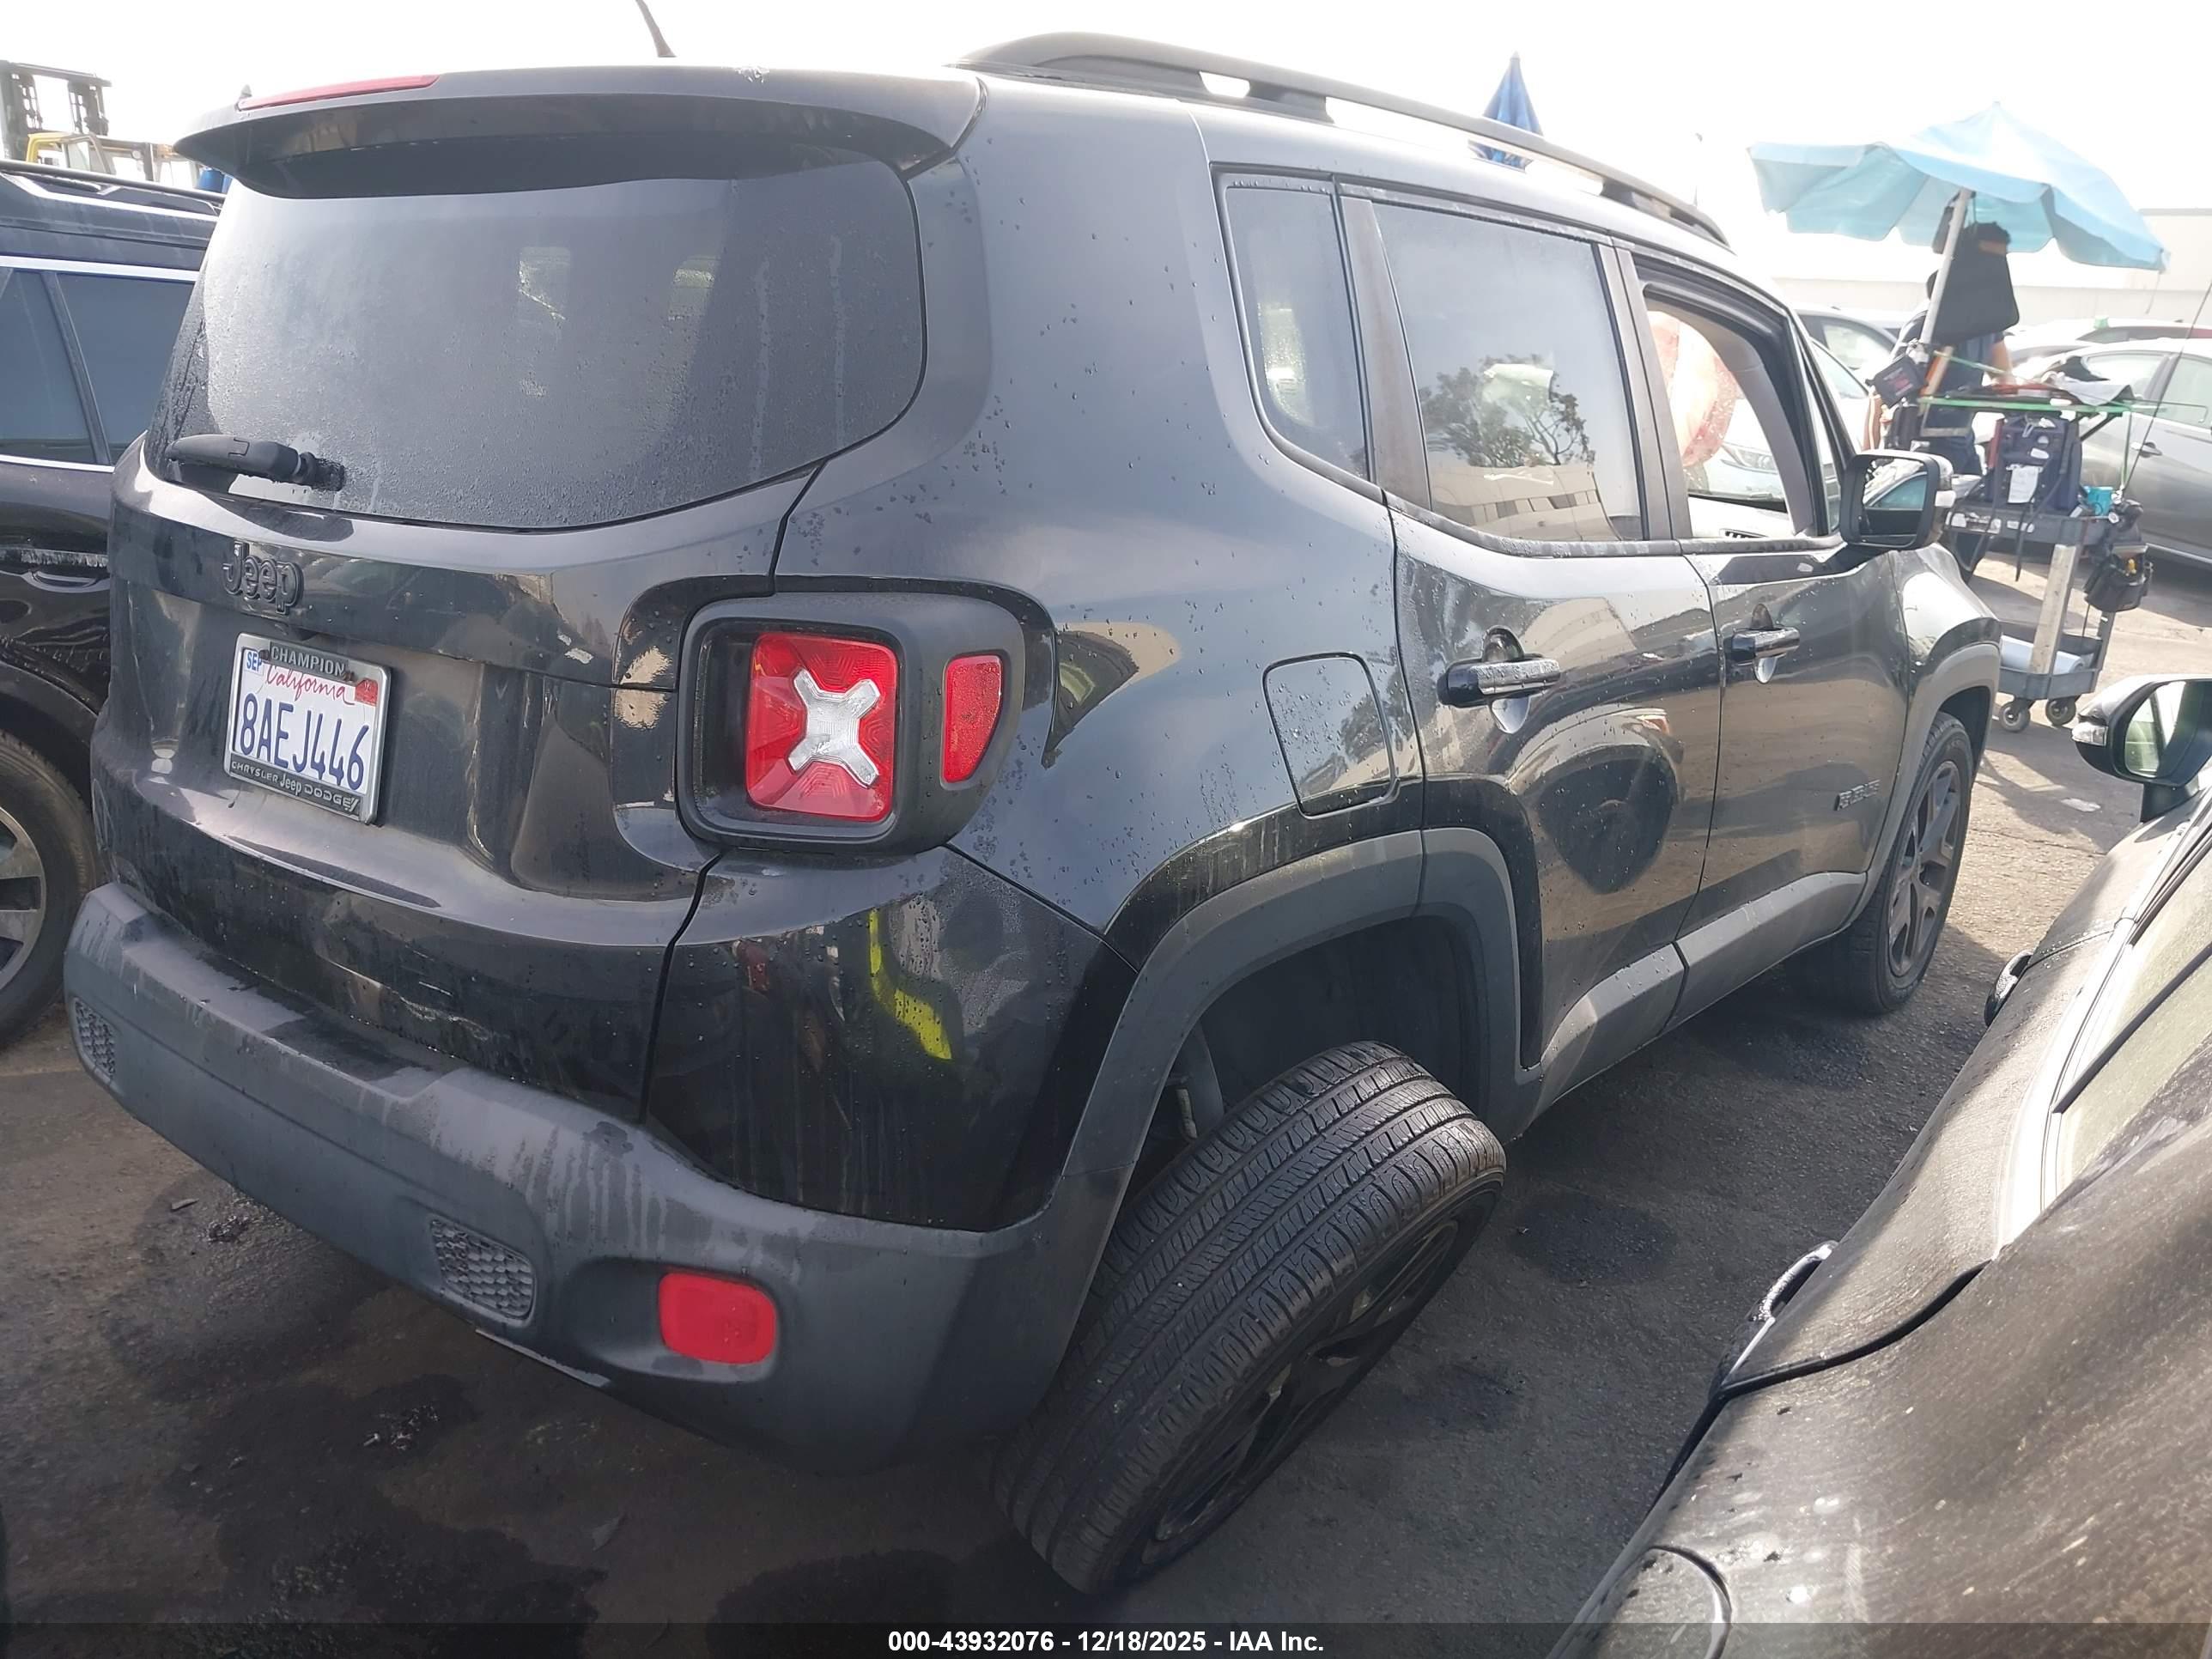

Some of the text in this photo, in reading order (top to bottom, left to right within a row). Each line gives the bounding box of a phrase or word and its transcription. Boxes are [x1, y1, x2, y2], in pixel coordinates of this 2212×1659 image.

[222, 538, 303, 615] Jeep
[266, 665, 356, 706] California
[270, 645, 346, 678] CHAMPION
[239, 692, 369, 791] 8AEJ446
[231, 761, 353, 809] CHRYSLER Jeep DODGE
